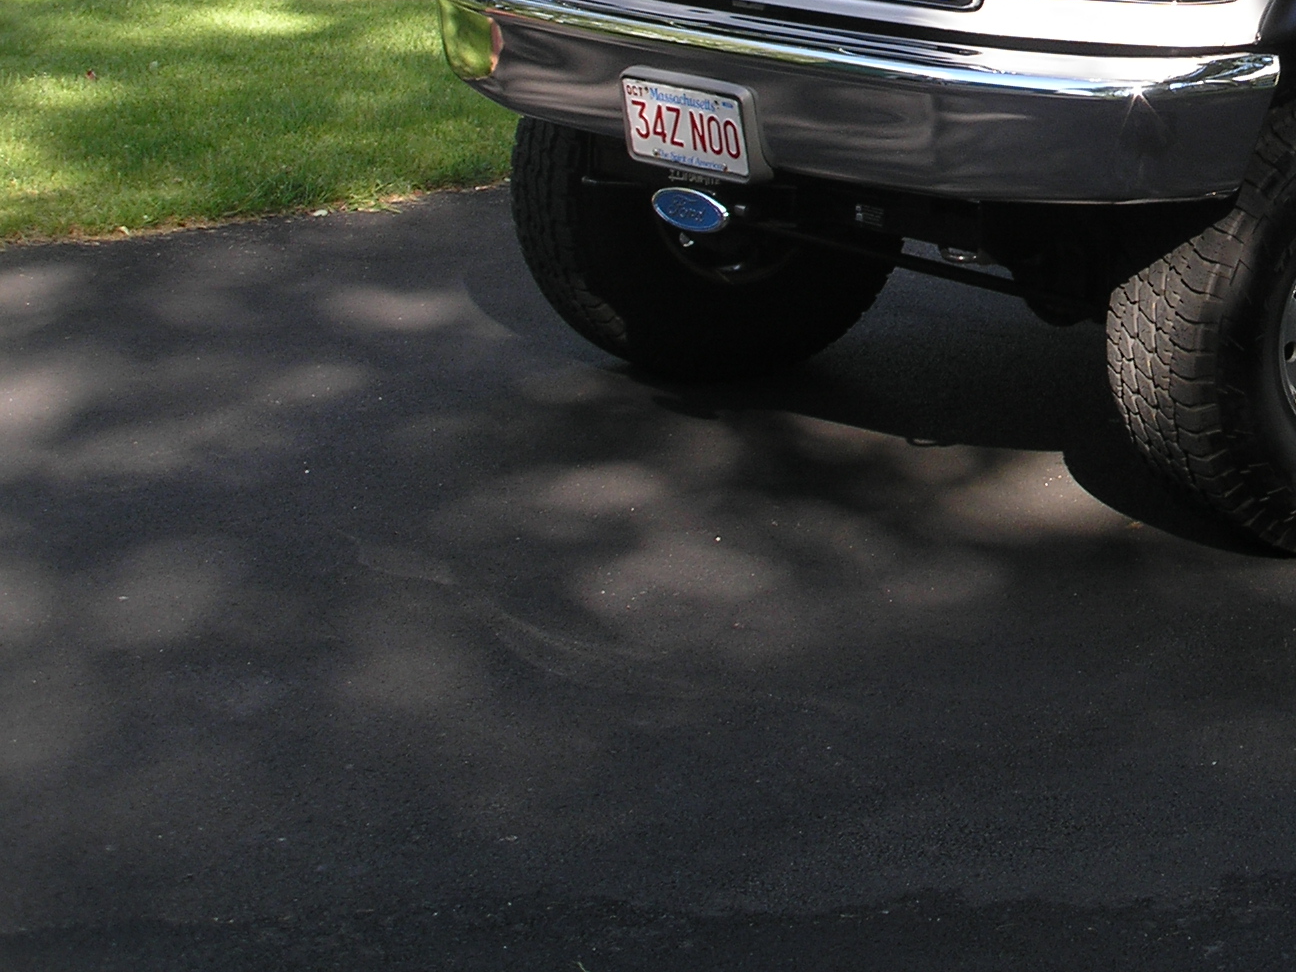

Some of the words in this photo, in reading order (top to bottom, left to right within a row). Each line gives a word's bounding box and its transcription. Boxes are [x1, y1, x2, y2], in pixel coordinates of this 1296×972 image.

[626, 84, 644, 97] OCT
[648, 86, 717, 112] Massachusetts
[631, 98, 685, 149] 34Z
[669, 193, 706, 223] Ford
